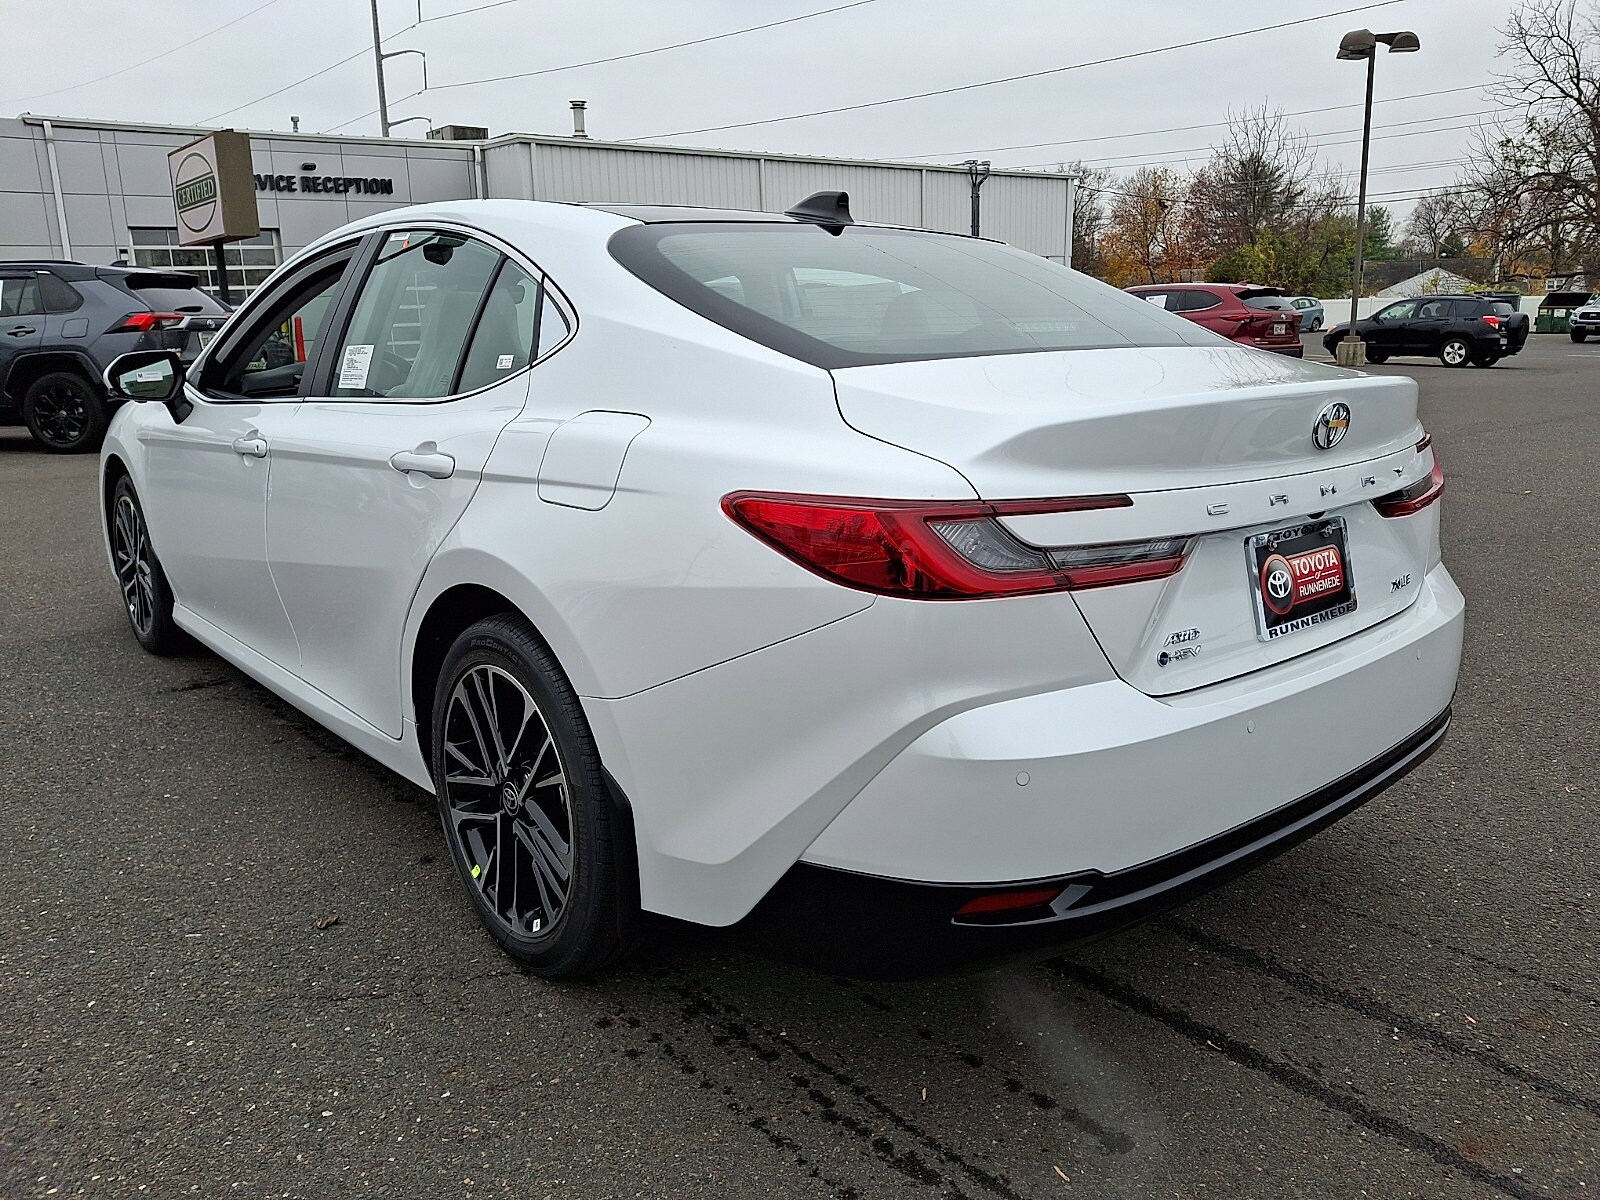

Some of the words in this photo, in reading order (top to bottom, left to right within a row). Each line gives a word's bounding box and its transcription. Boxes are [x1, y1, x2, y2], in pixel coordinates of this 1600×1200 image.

[176, 178, 216, 207] CERTIFIED
[301, 176, 394, 195] RECEPTION
[1206, 466, 1405, 516] CAMRY
[1292, 550, 1339, 576] TOYOTA
[1299, 575, 1341, 597] RUNNEMEDE
[1268, 602, 1354, 639] RUNNEMEDE
